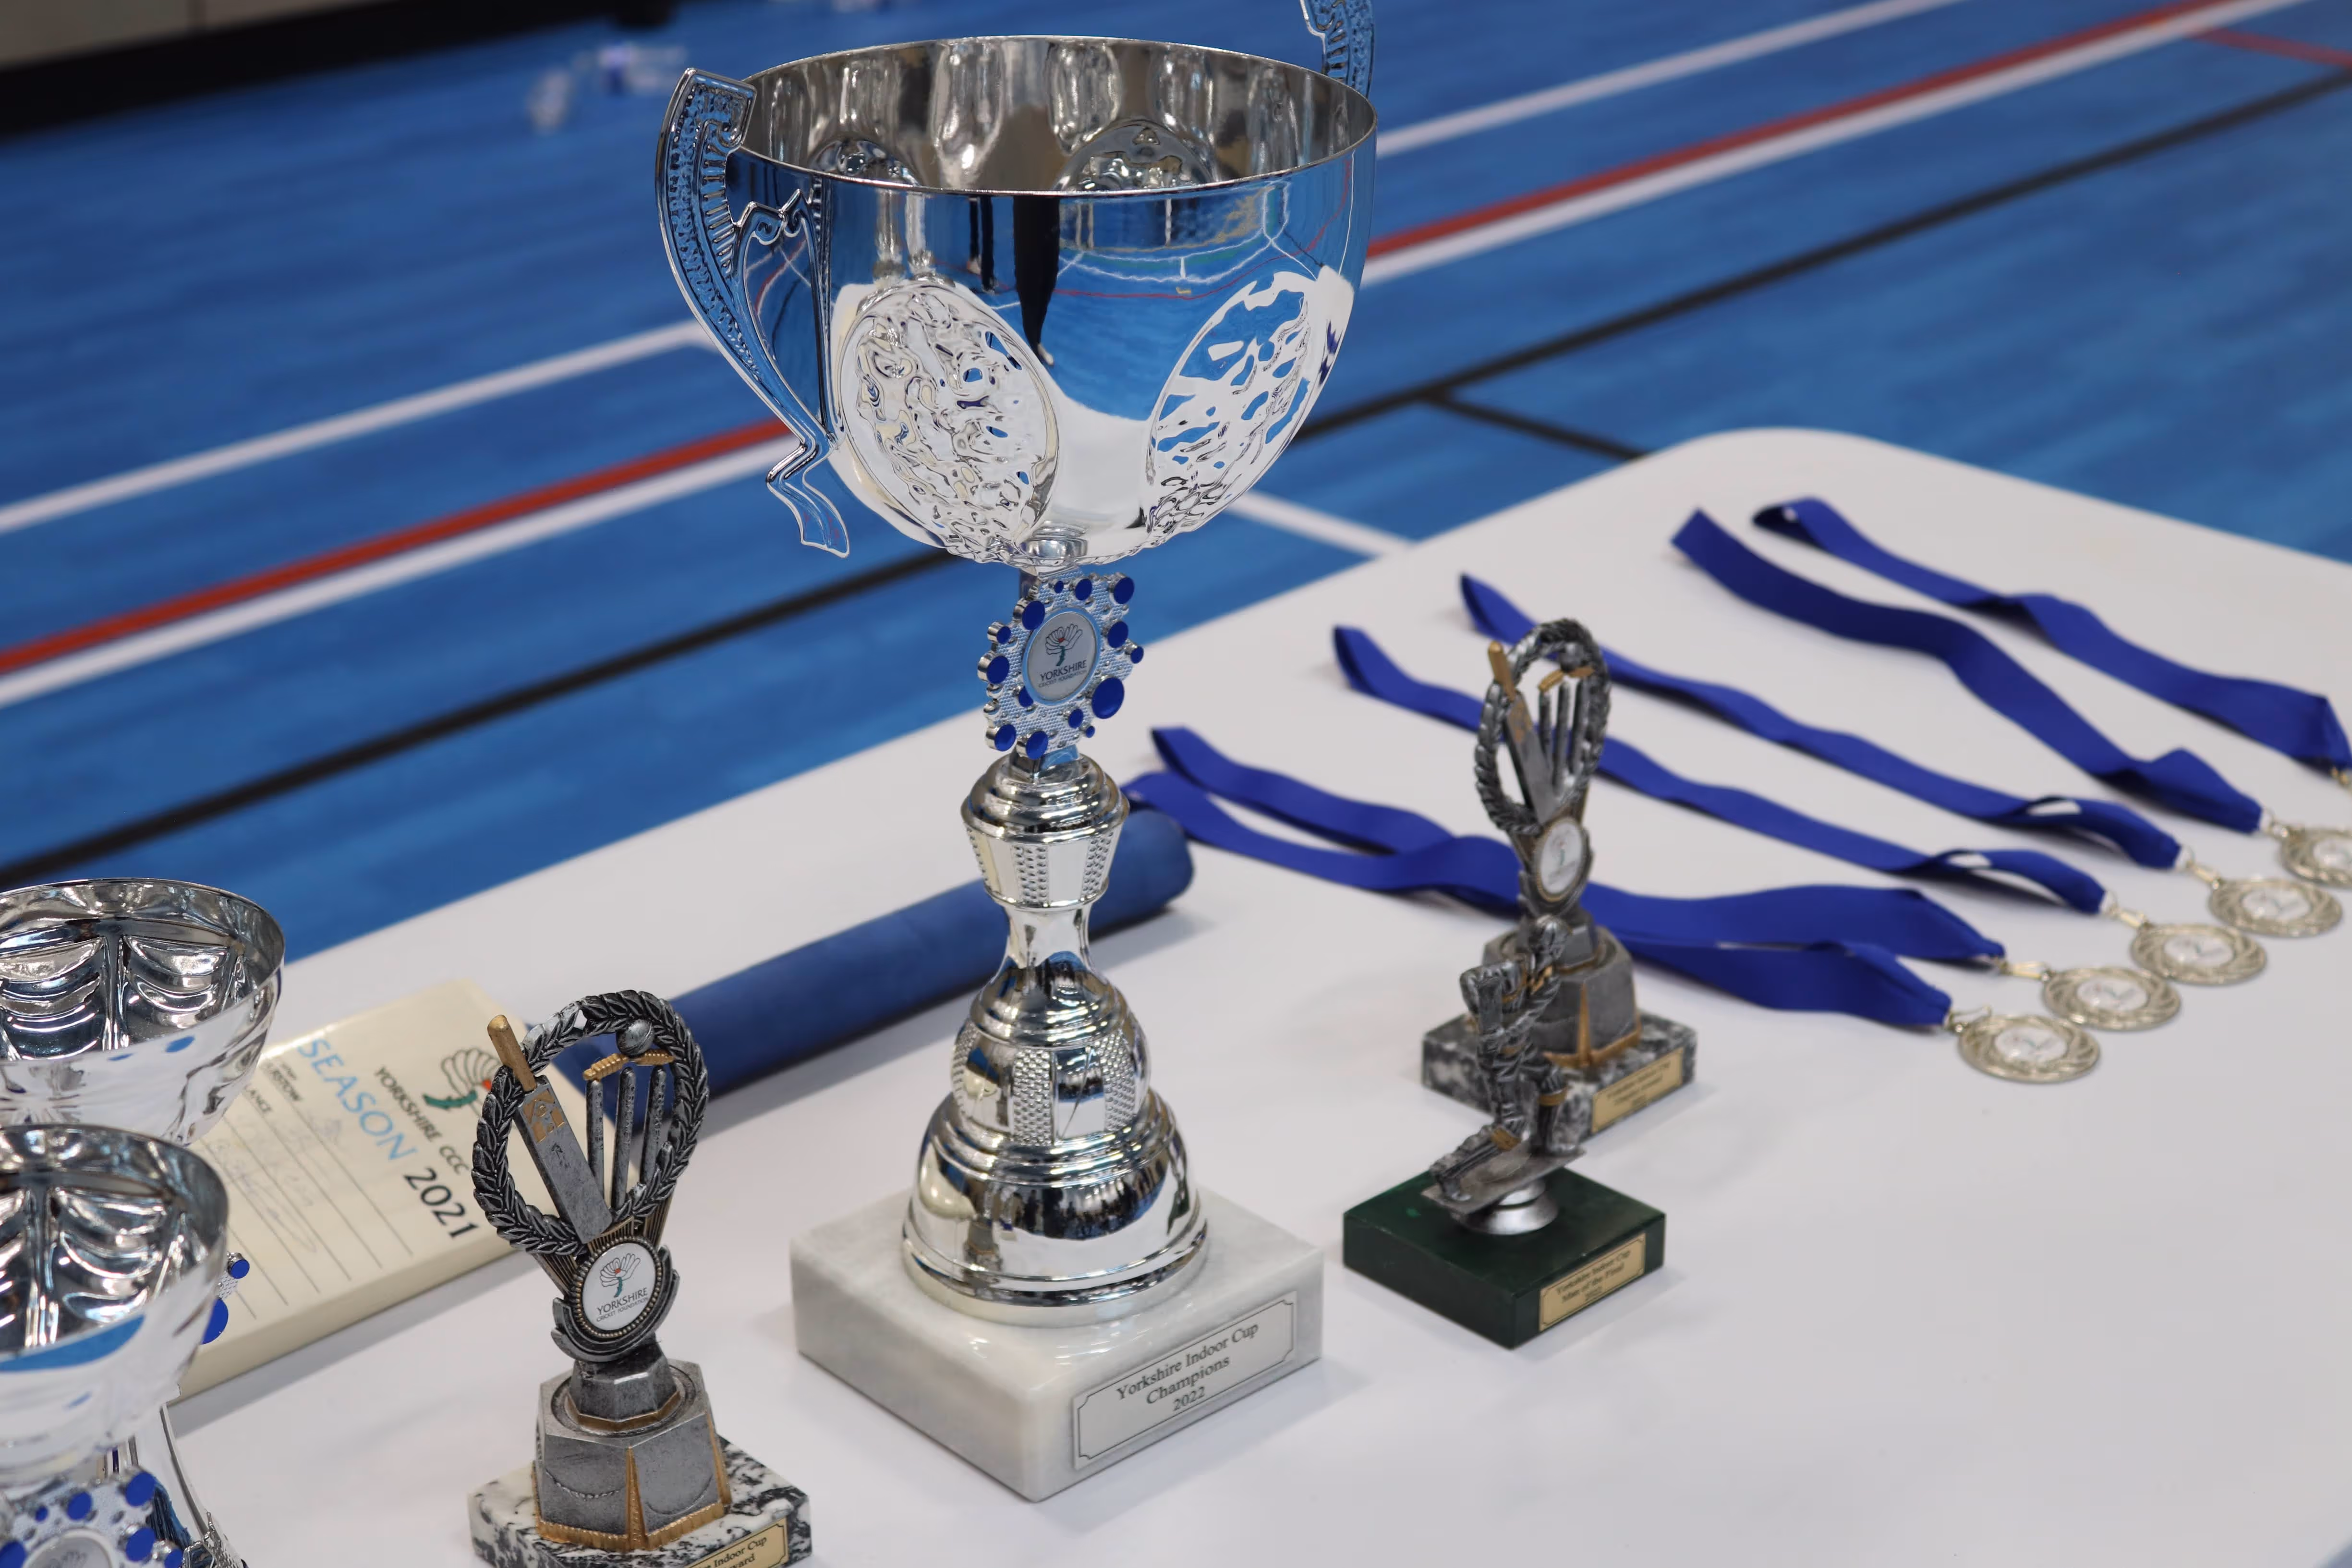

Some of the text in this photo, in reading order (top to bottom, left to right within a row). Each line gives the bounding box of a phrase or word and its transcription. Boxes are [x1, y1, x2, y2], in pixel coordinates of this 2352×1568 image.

[1040, 660, 1087, 681] YORKSHIRE
[297, 1038, 418, 1161] SEASON
[375, 1066, 470, 1175] YORKSHIRE CCC
[404, 1167, 479, 1240] 2021
[597, 1288, 648, 1315] YORKSHIRE
[1116, 1324, 1259, 1400] Yorkshire Indoor Cup
[1146, 1356, 1230, 1404] Champions
[1172, 1386, 1206, 1411] 2022
[714, 1537, 767, 1568] Indoor Cup
